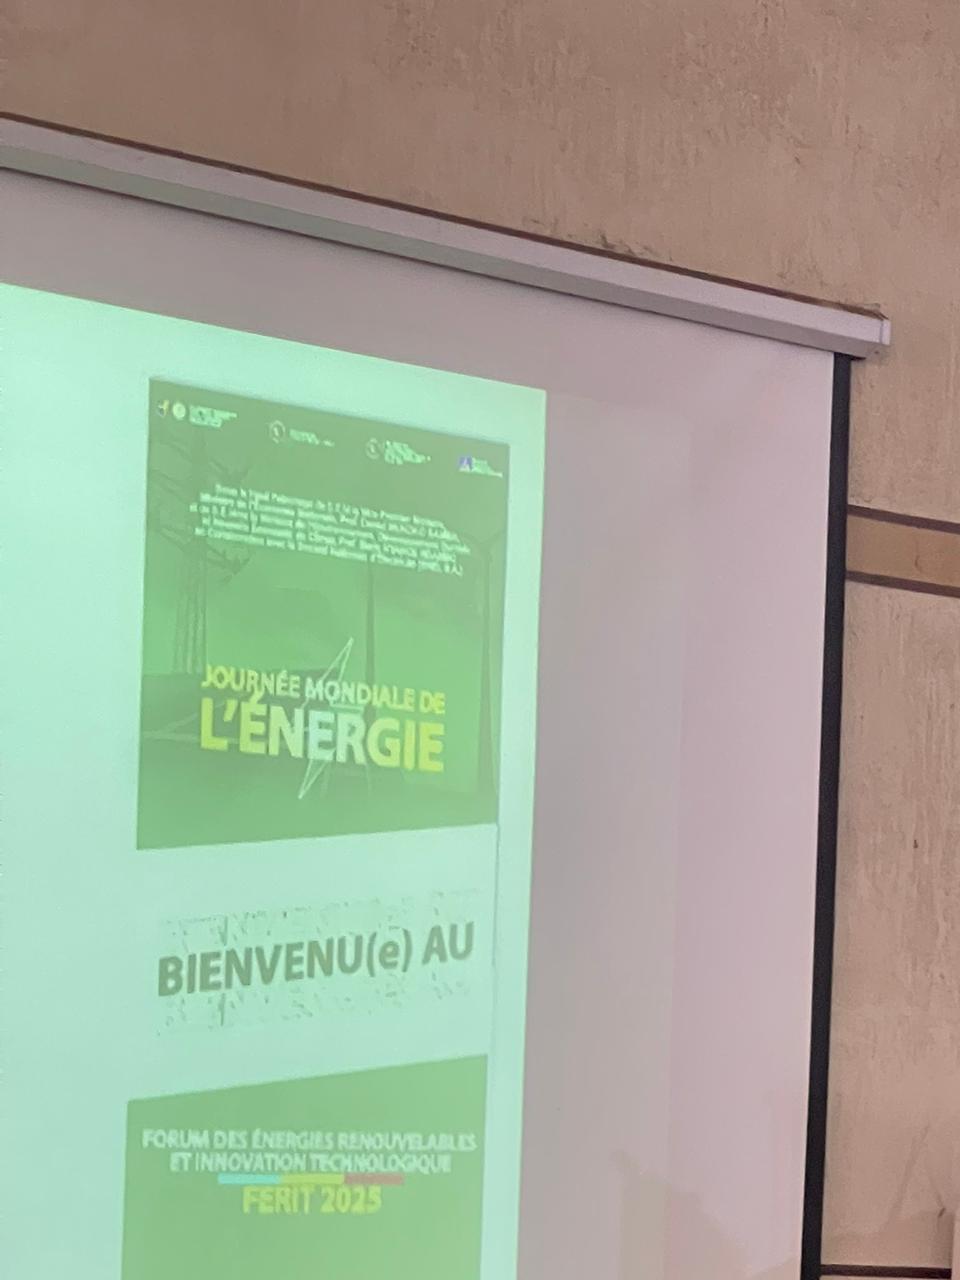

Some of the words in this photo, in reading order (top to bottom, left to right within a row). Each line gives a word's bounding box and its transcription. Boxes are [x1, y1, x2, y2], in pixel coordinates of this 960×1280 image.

[201, 664, 301, 698] JOURNÉE
[305, 677, 415, 712] MONDIALE
[419, 690, 446, 715] DE
[158, 927, 413, 997] BIENVENU(e)
[422, 921, 475, 966] AU
[142, 1129, 210, 1149] FORUM
[213, 1131, 248, 1149] DES
[170, 1152, 193, 1172] ET
[195, 1152, 307, 1173] INNOVATION
[310, 1153, 451, 1175] TECHNOLOGIQUE
[242, 1184, 315, 1214] FERIT
[320, 1185, 382, 1214] 2025
